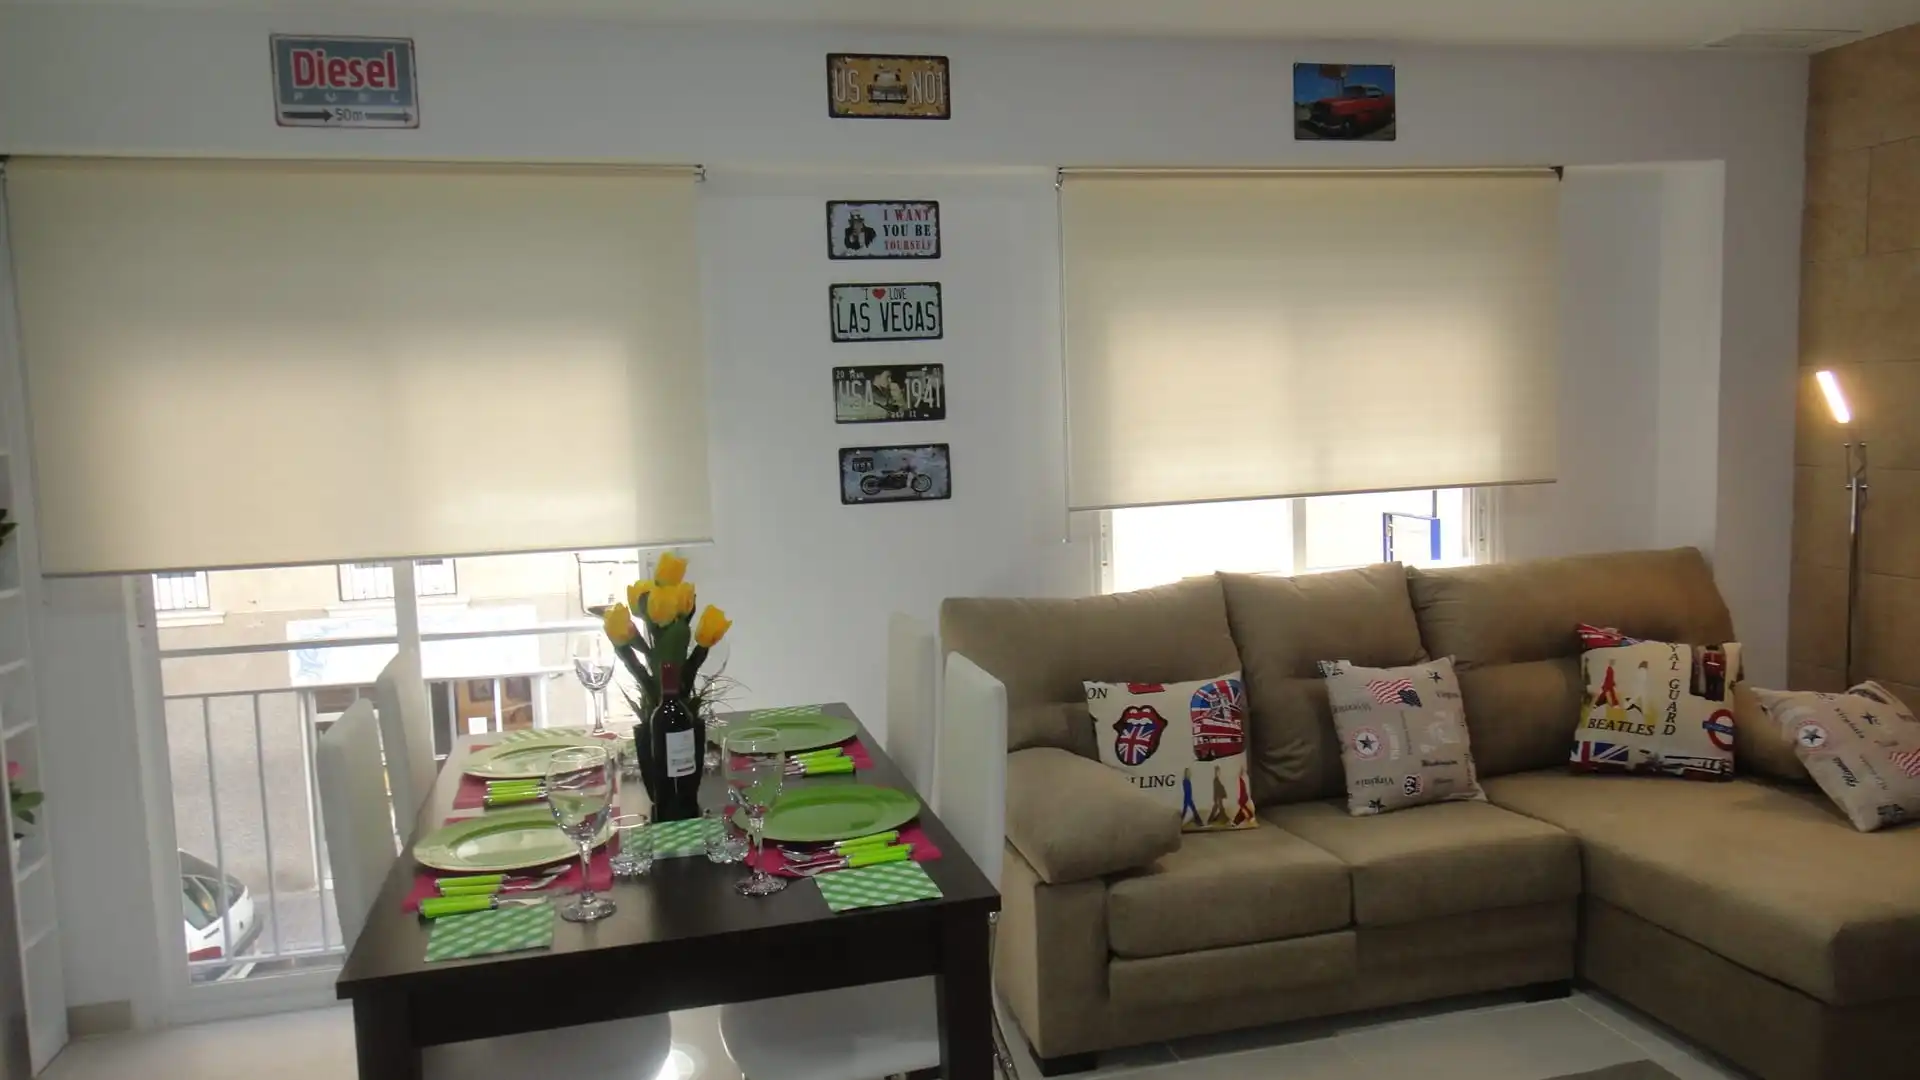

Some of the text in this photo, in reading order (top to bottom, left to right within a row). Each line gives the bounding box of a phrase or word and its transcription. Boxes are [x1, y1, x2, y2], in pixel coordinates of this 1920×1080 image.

[291, 49, 397, 89] Diesel
[834, 69, 860, 103] US
[884, 208, 931, 221] I WANT
[882, 224, 931, 237] YOU BE
[863, 288, 907, 300] I LOVE
[837, 301, 936, 333] LAS VEGAS
[839, 380, 874, 406] USA
[905, 378, 940, 408] 1941
[1662, 642, 1680, 735] YAL GUARD
[1588, 718, 1655, 736] BEATLES
[1126, 774, 1176, 788] LING
